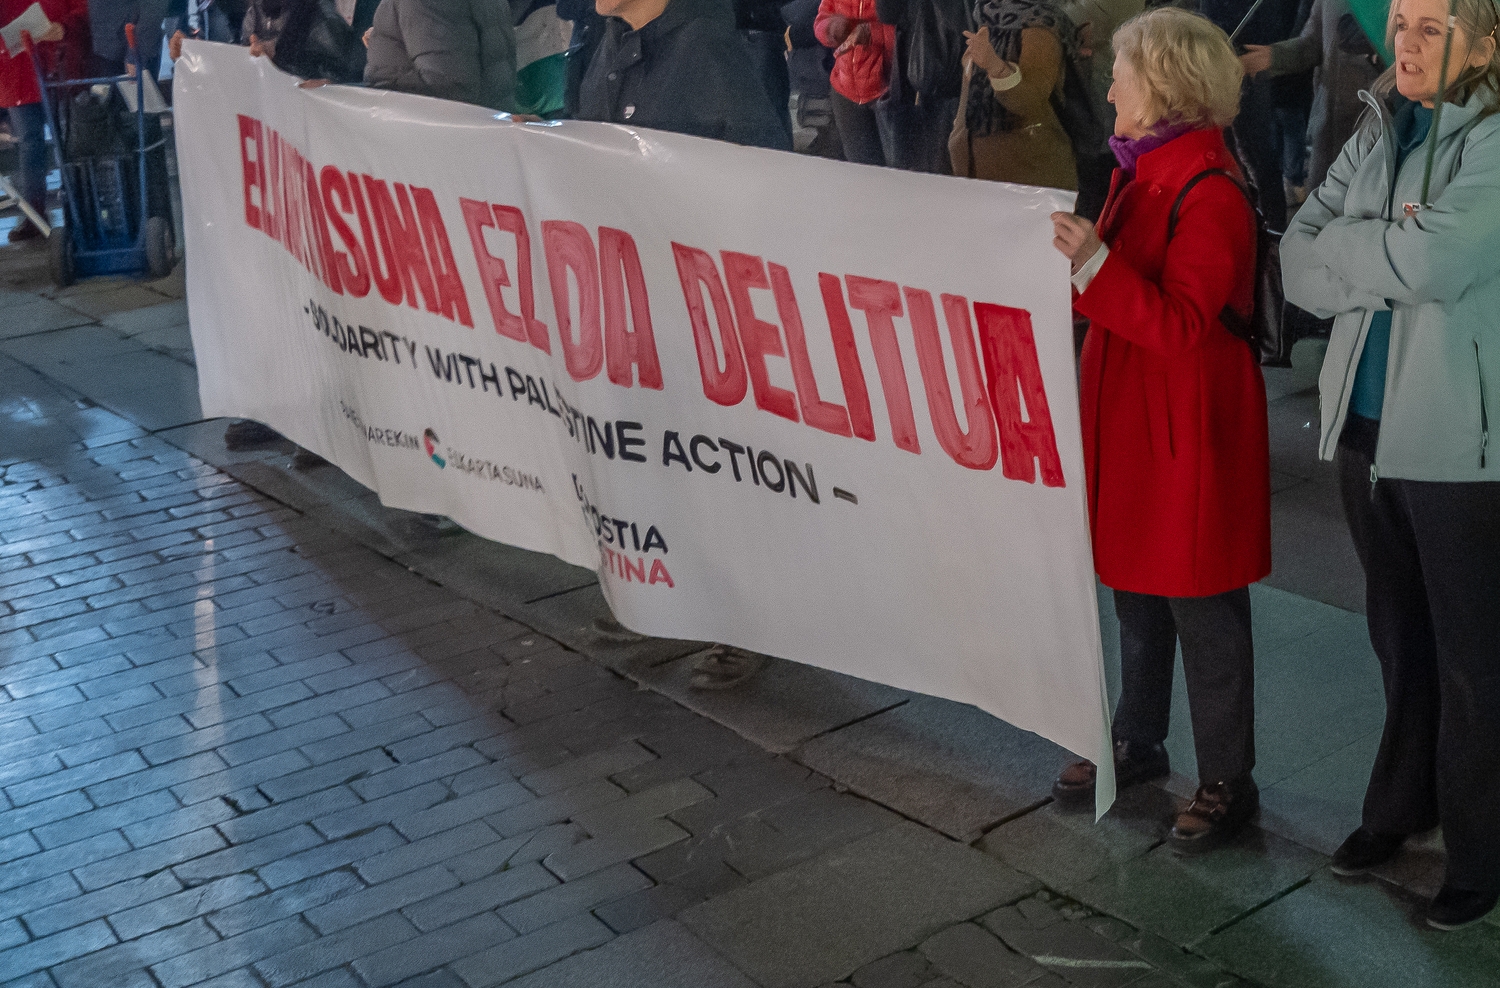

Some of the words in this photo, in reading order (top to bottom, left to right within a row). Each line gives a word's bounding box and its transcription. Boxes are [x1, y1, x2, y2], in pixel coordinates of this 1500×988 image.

[237, 114, 475, 329] ELKASUNA
[458, 197, 551, 357] EZ
[541, 220, 664, 391] DA
[671, 241, 1066, 488] DELITUA
[425, 345, 504, 398] WITH
[662, 430, 821, 505] ACTION
